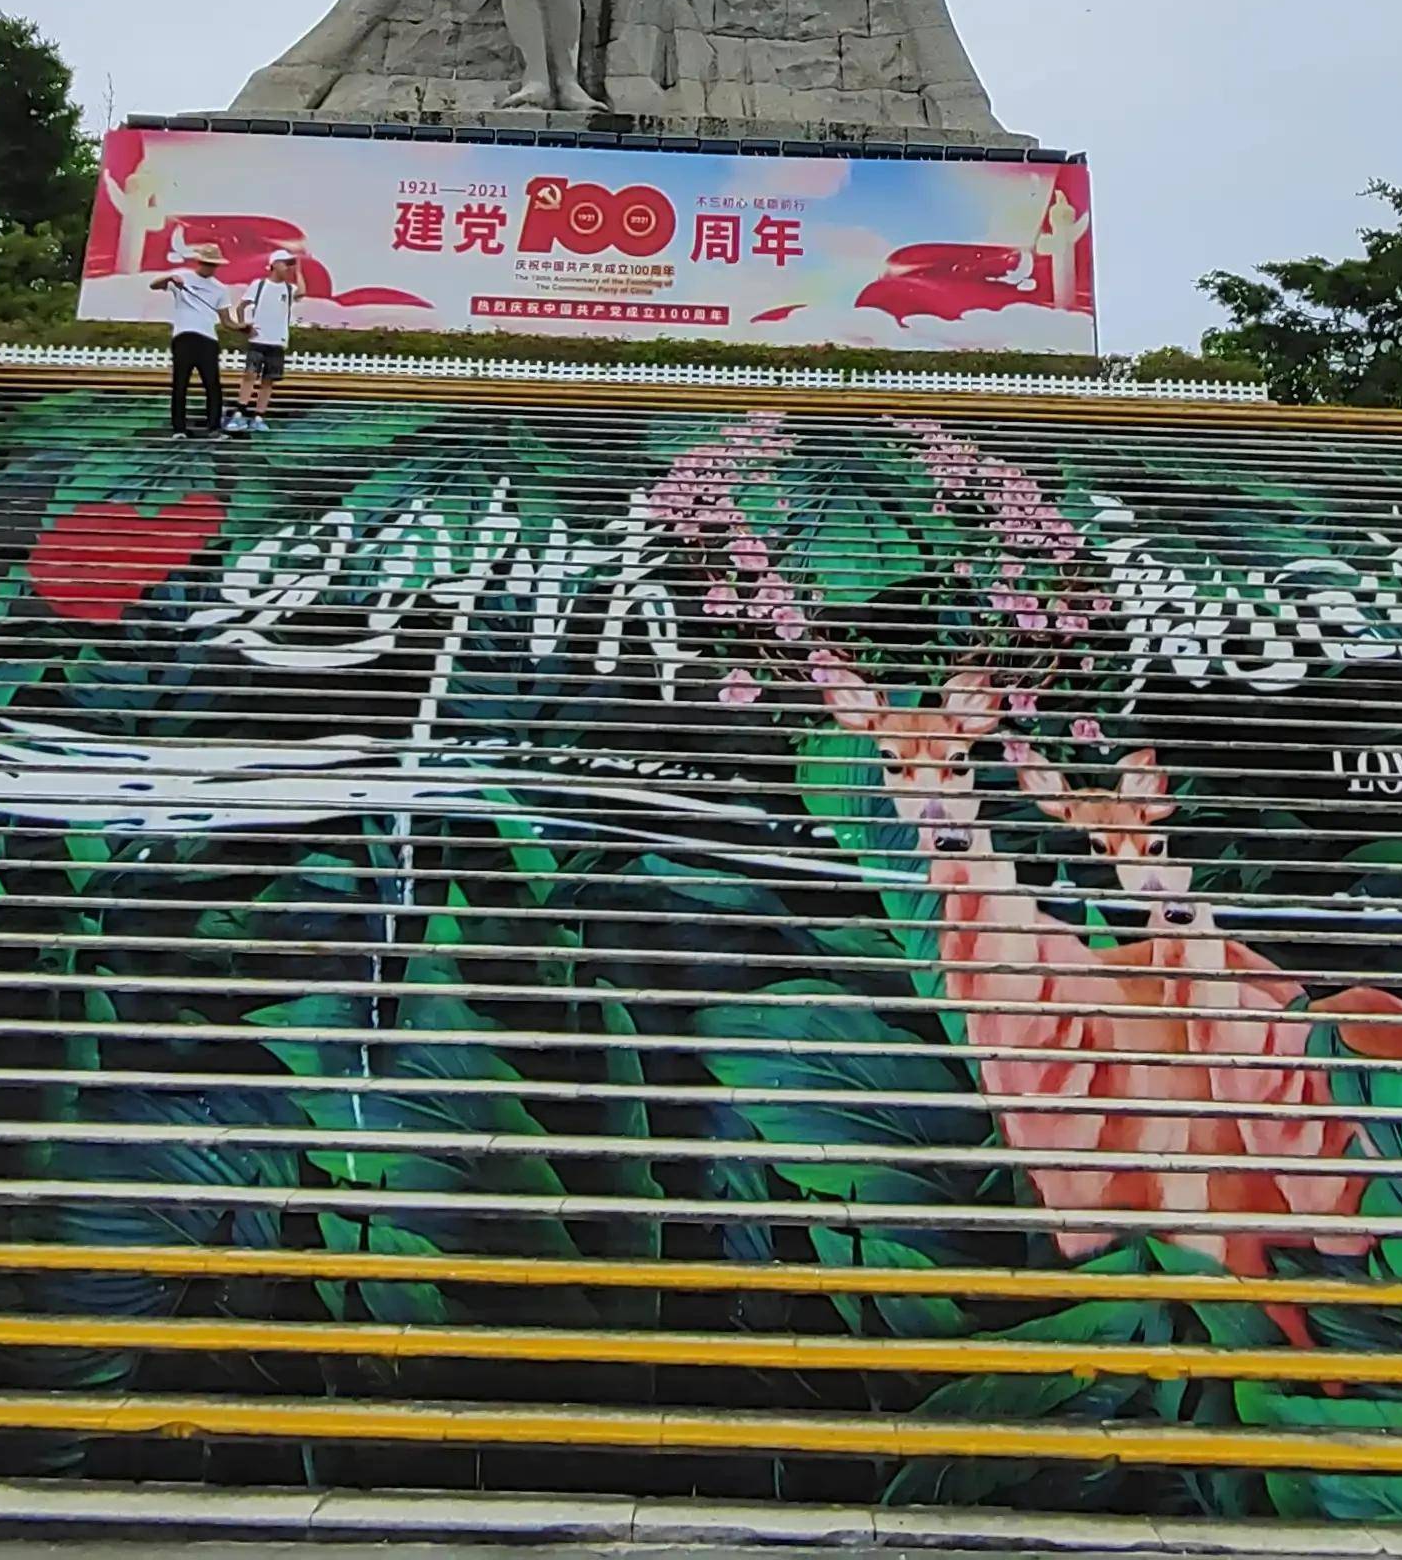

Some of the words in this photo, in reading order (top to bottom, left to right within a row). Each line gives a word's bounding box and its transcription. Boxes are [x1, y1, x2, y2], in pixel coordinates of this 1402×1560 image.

[392, 200, 508, 254] 建党
[516, 176, 677, 257] 100
[690, 214, 804, 266] 周年
[515, 259, 675, 276] 庆祝中国共产党成立100周年
[477, 299, 723, 321] 热烈庆祝中国共产党成立100周年
